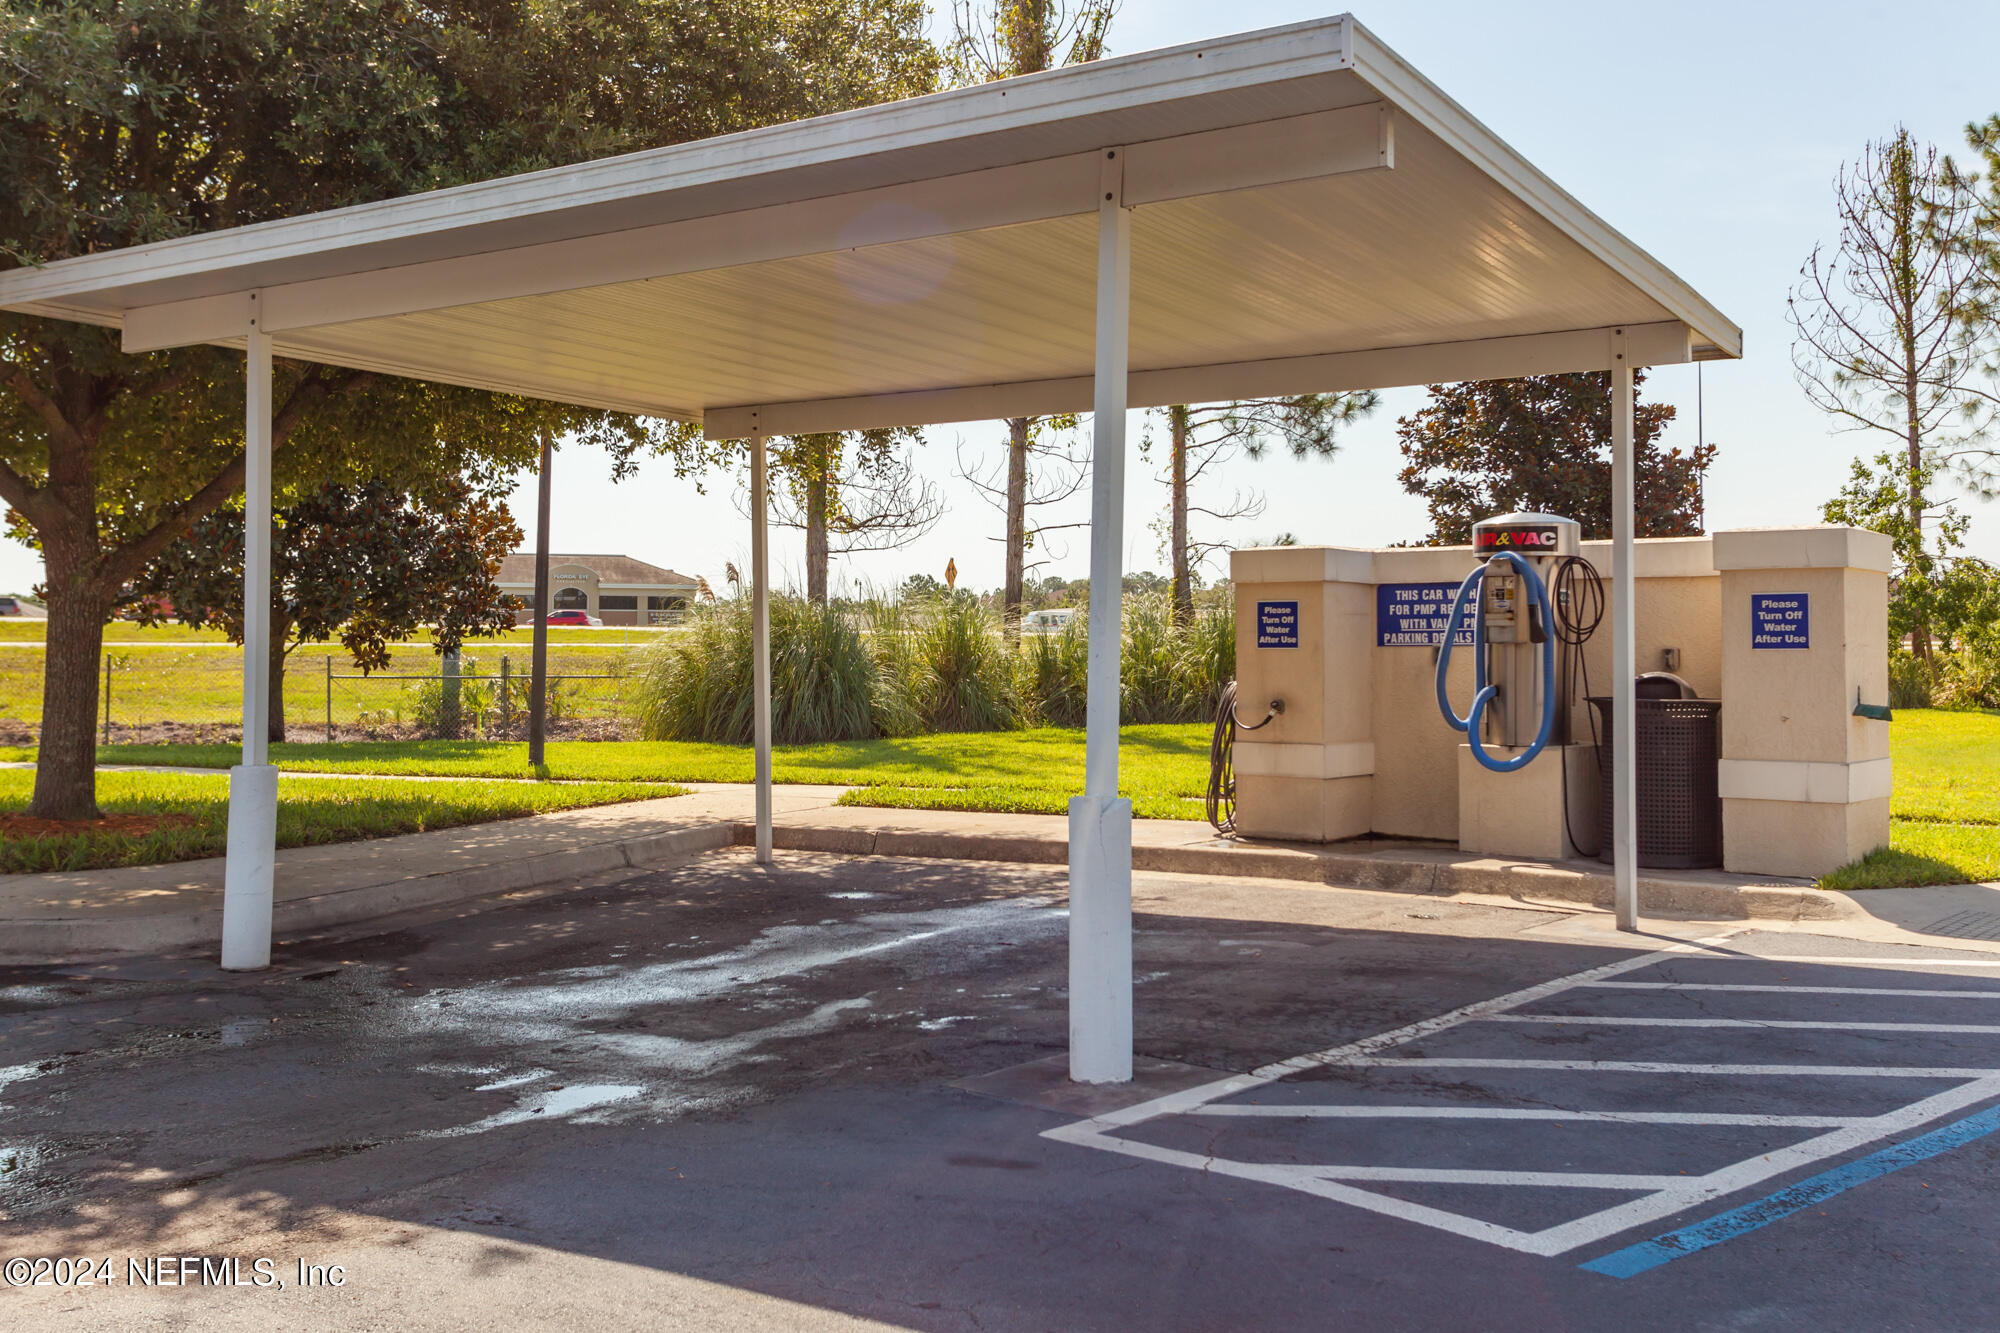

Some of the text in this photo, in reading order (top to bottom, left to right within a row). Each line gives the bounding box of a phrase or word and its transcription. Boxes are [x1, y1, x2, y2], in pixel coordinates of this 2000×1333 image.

[1395, 588, 1476, 601] THIS CAR WH
[1761, 599, 1798, 609] Please
[1264, 606, 1292, 614] Please
[1389, 604, 1410, 615] FOR
[1413, 604, 1437, 615] PMP
[1261, 615, 1295, 624] Turn Off
[1757, 610, 1803, 620] Turn Off
[1400, 618, 1427, 629] WITH
[1763, 622, 1797, 632] Water
[1265, 625, 1291, 634] Water
[1258, 635, 1297, 644] After Use
[1384, 631, 1473, 644] PARKING DEALS
[1754, 633, 1807, 644] After Use
